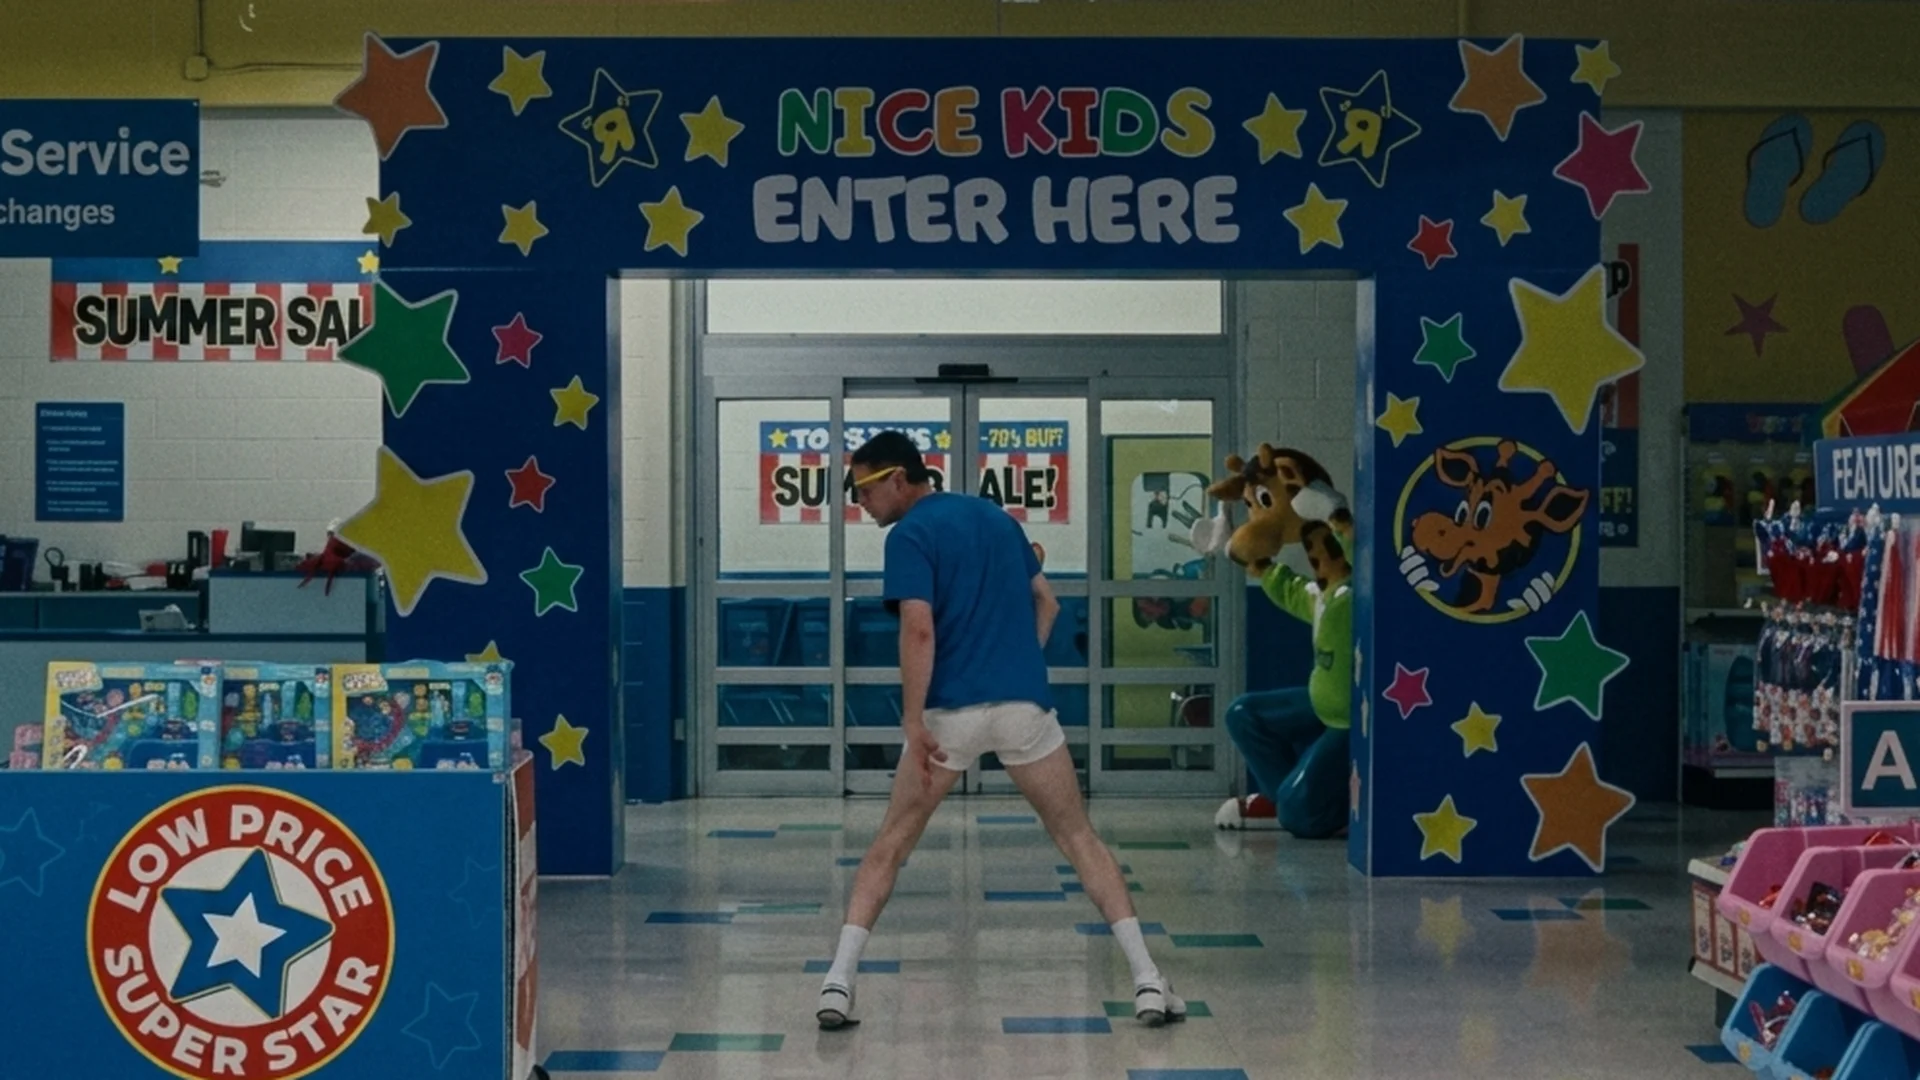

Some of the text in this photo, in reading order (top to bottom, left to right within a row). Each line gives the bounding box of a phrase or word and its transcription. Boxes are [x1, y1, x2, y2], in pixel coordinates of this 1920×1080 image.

[1, 126, 191, 177] Service
[777, 85, 1217, 159] NICE KIDS
[752, 173, 1241, 245] ENTER HERE
[74, 294, 369, 348] SUMMER SAL
[979, 466, 1057, 508] ALE!
[1861, 729, 1918, 791] A
[107, 803, 374, 918] LOW PRICE
[103, 943, 381, 1077] SUPER STAR
